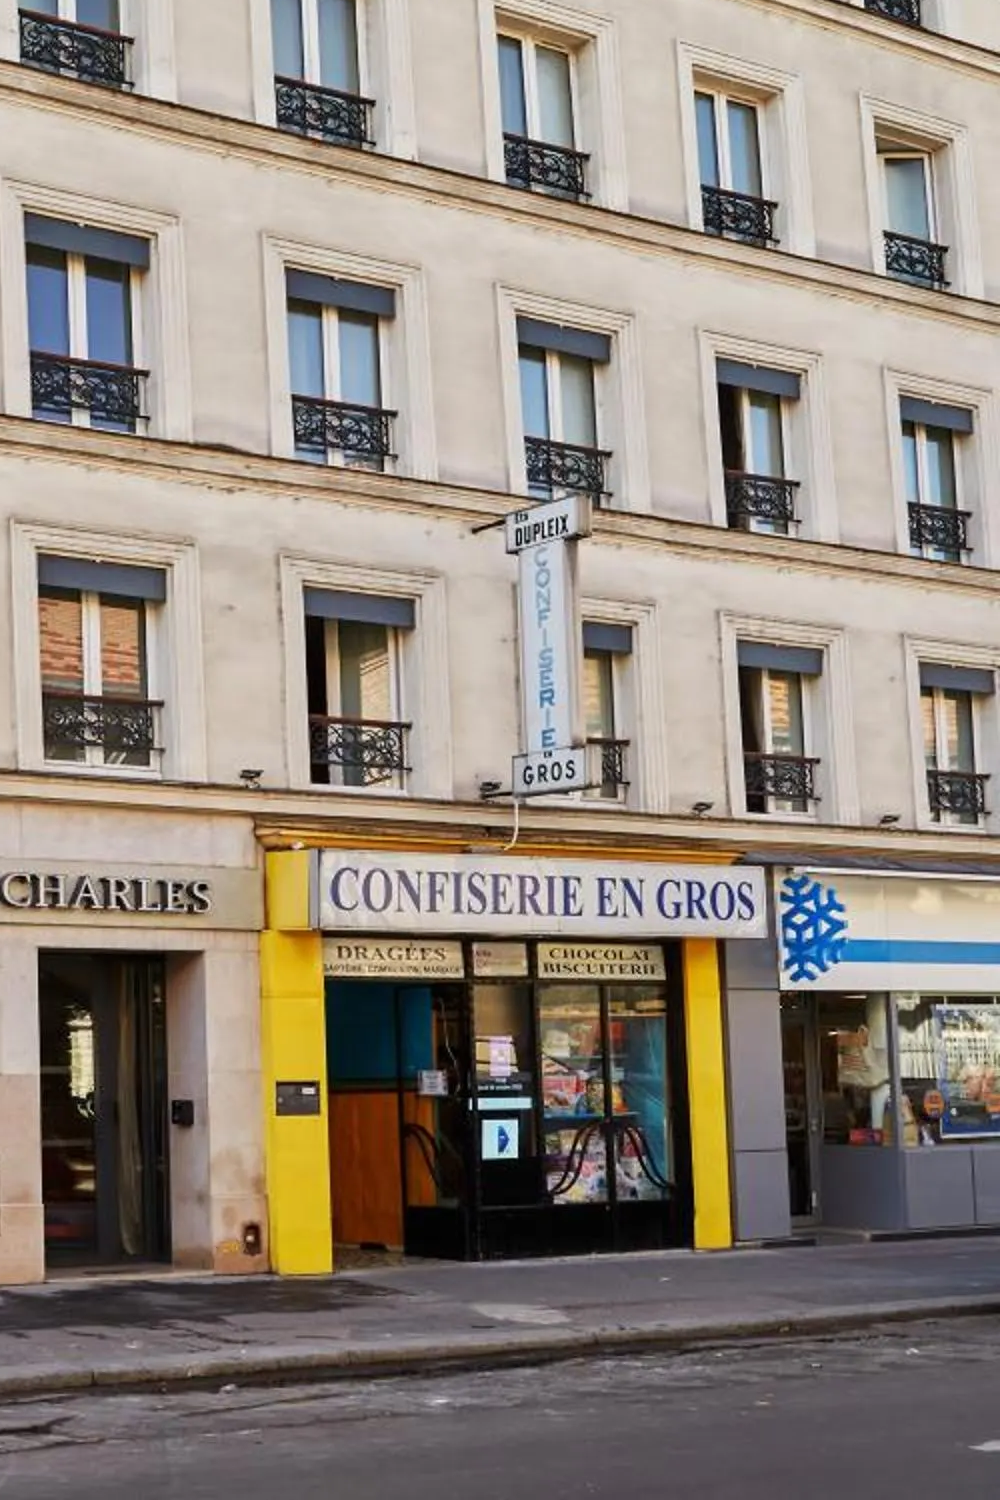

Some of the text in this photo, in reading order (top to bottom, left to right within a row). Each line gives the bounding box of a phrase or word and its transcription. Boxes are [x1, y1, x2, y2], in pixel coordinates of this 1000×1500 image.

[515, 513, 569, 547] DUPLEIX
[534, 547, 557, 748] CONFISERIE
[523, 759, 576, 785] GROS
[329, 866, 756, 922] CONFISERIE EN GROS
[336, 942, 447, 961] DRAGÉES
[549, 947, 649, 961] CHOCOLAT
[543, 962, 659, 975] BISCUITERIE
